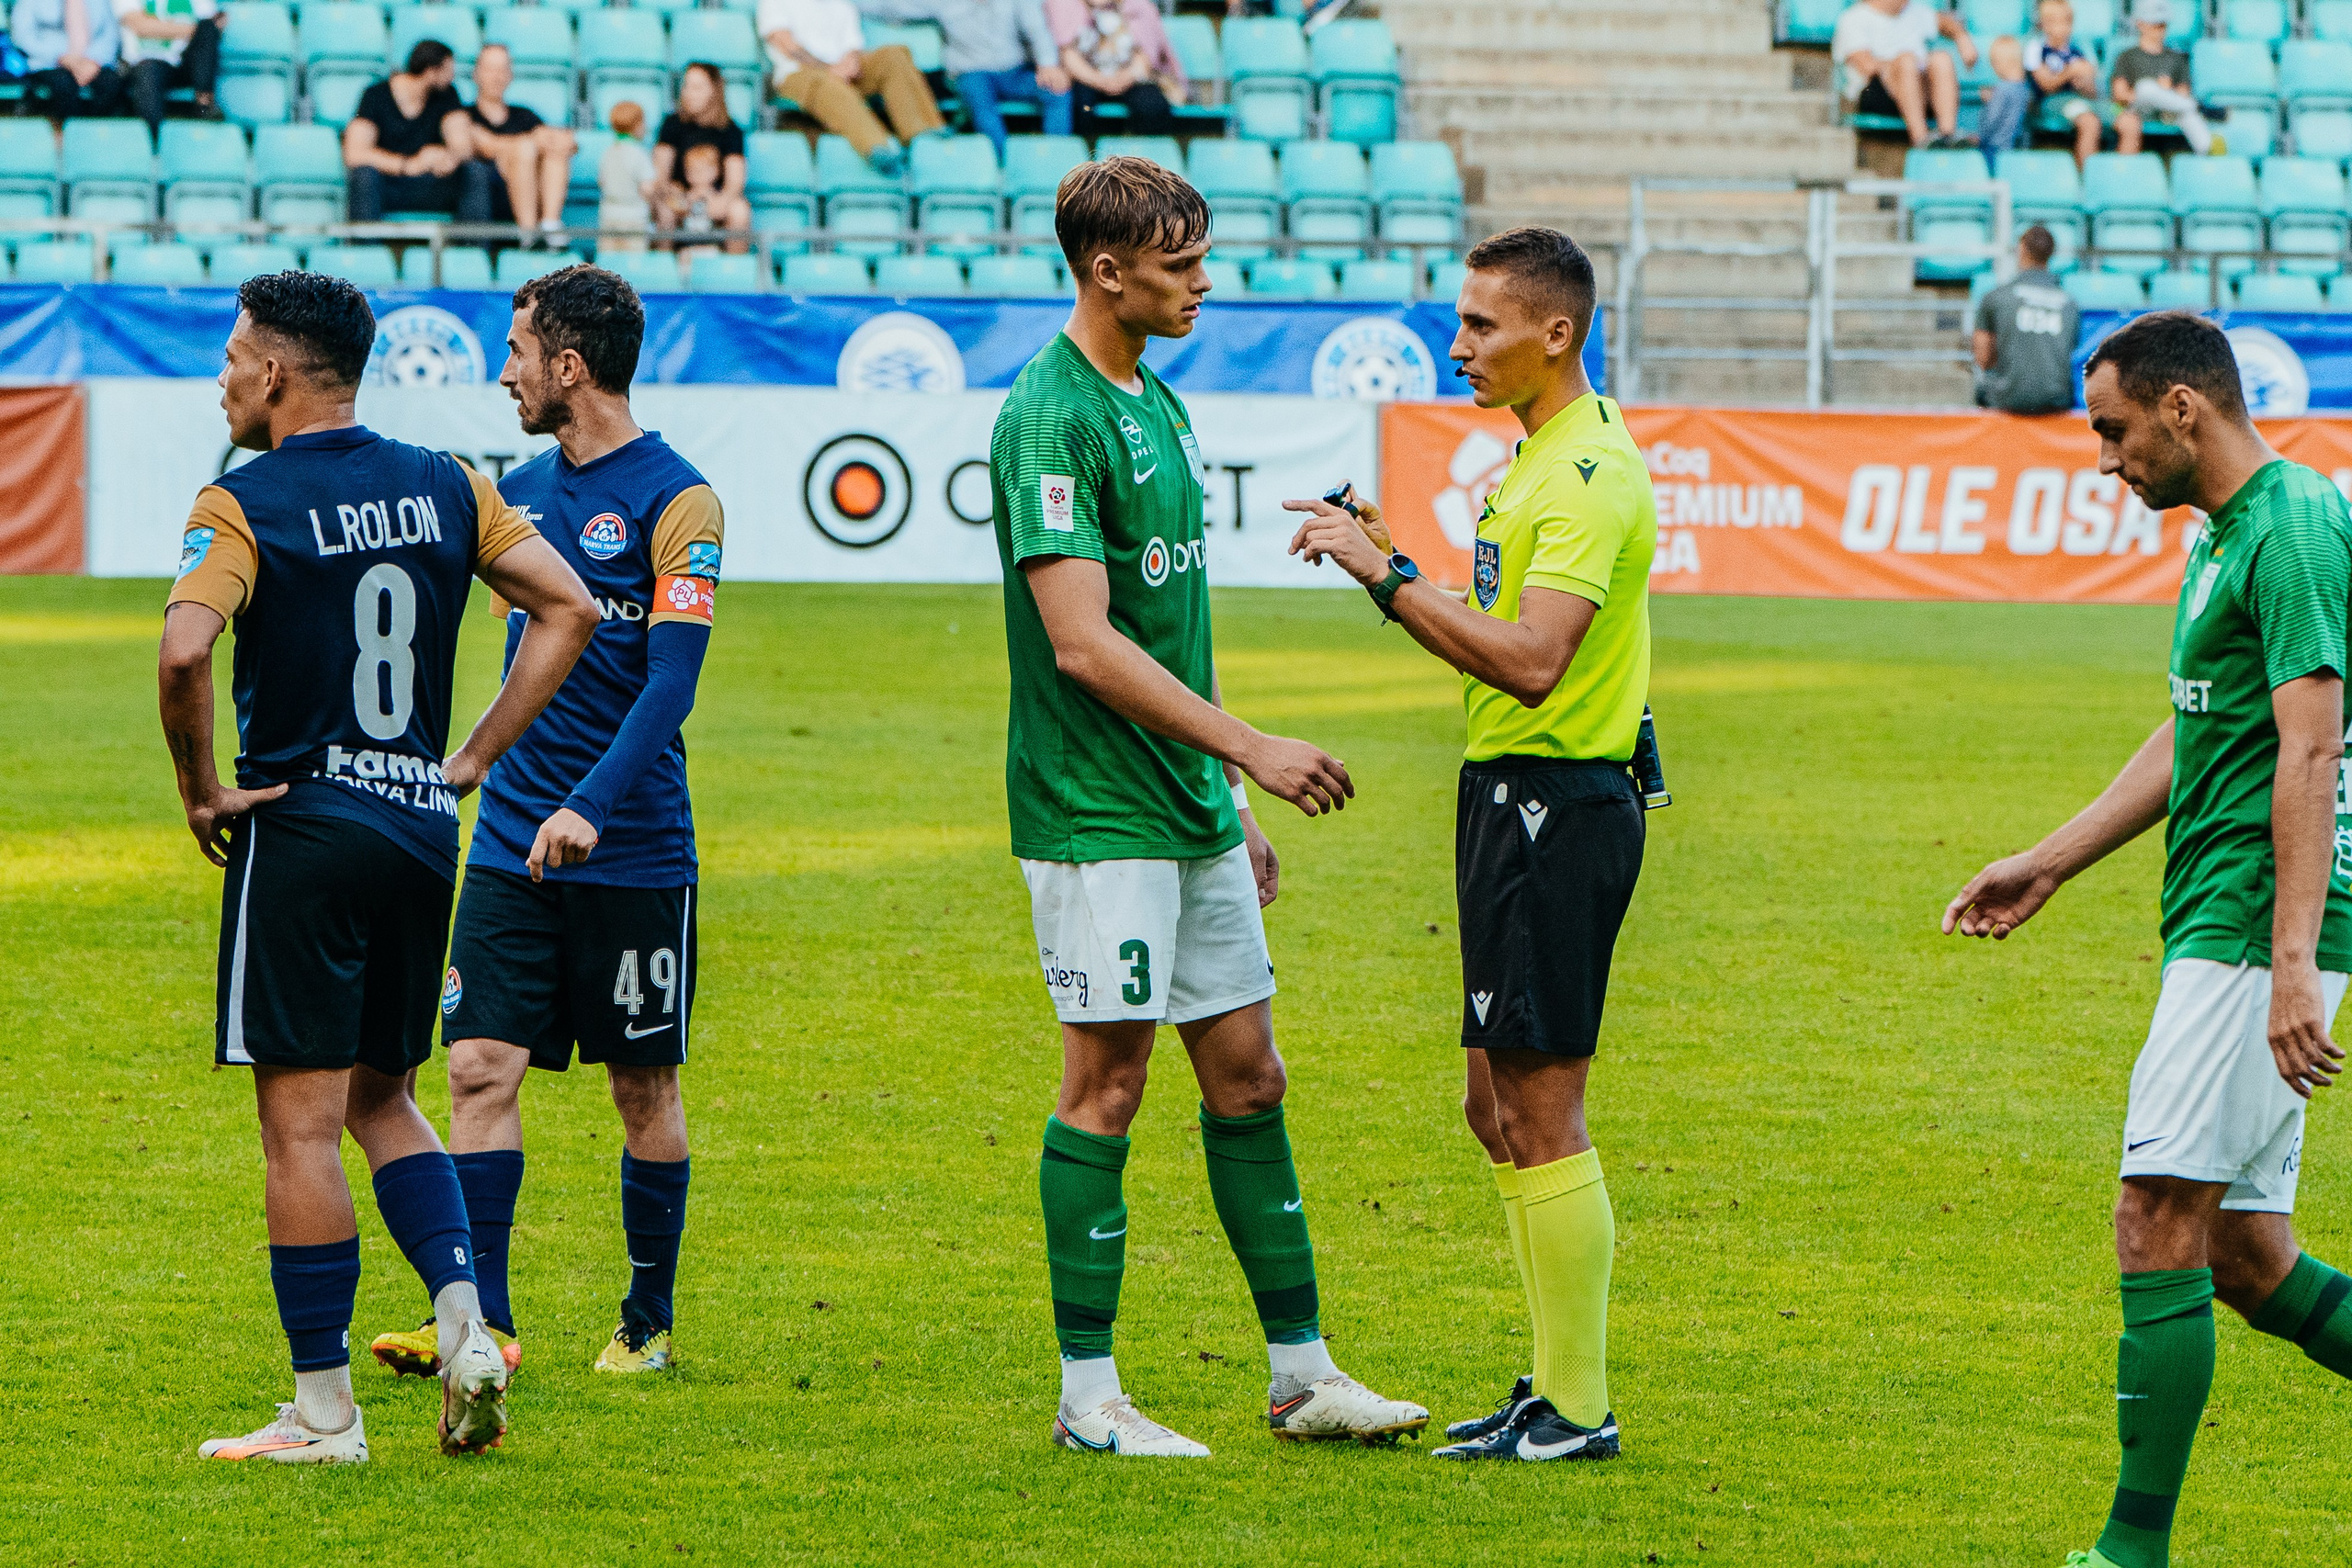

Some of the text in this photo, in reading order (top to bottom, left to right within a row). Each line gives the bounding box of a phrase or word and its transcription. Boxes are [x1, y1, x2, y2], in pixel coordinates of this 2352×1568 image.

[1131, 446, 1154, 460] OPEL
[309, 495, 443, 556] L.ROLON
[1654, 482, 1804, 530] EMIUM
[1840, 464, 1998, 555] OLE
[2007, 466, 2165, 557] OSA
[583, 538, 603, 549] NARVA
[353, 562, 416, 740] 8
[614, 947, 677, 1016] 49
[1118, 938, 1152, 1007] 3
[453, 1246, 467, 1266] 8
[342, 1329, 350, 1349] 8
